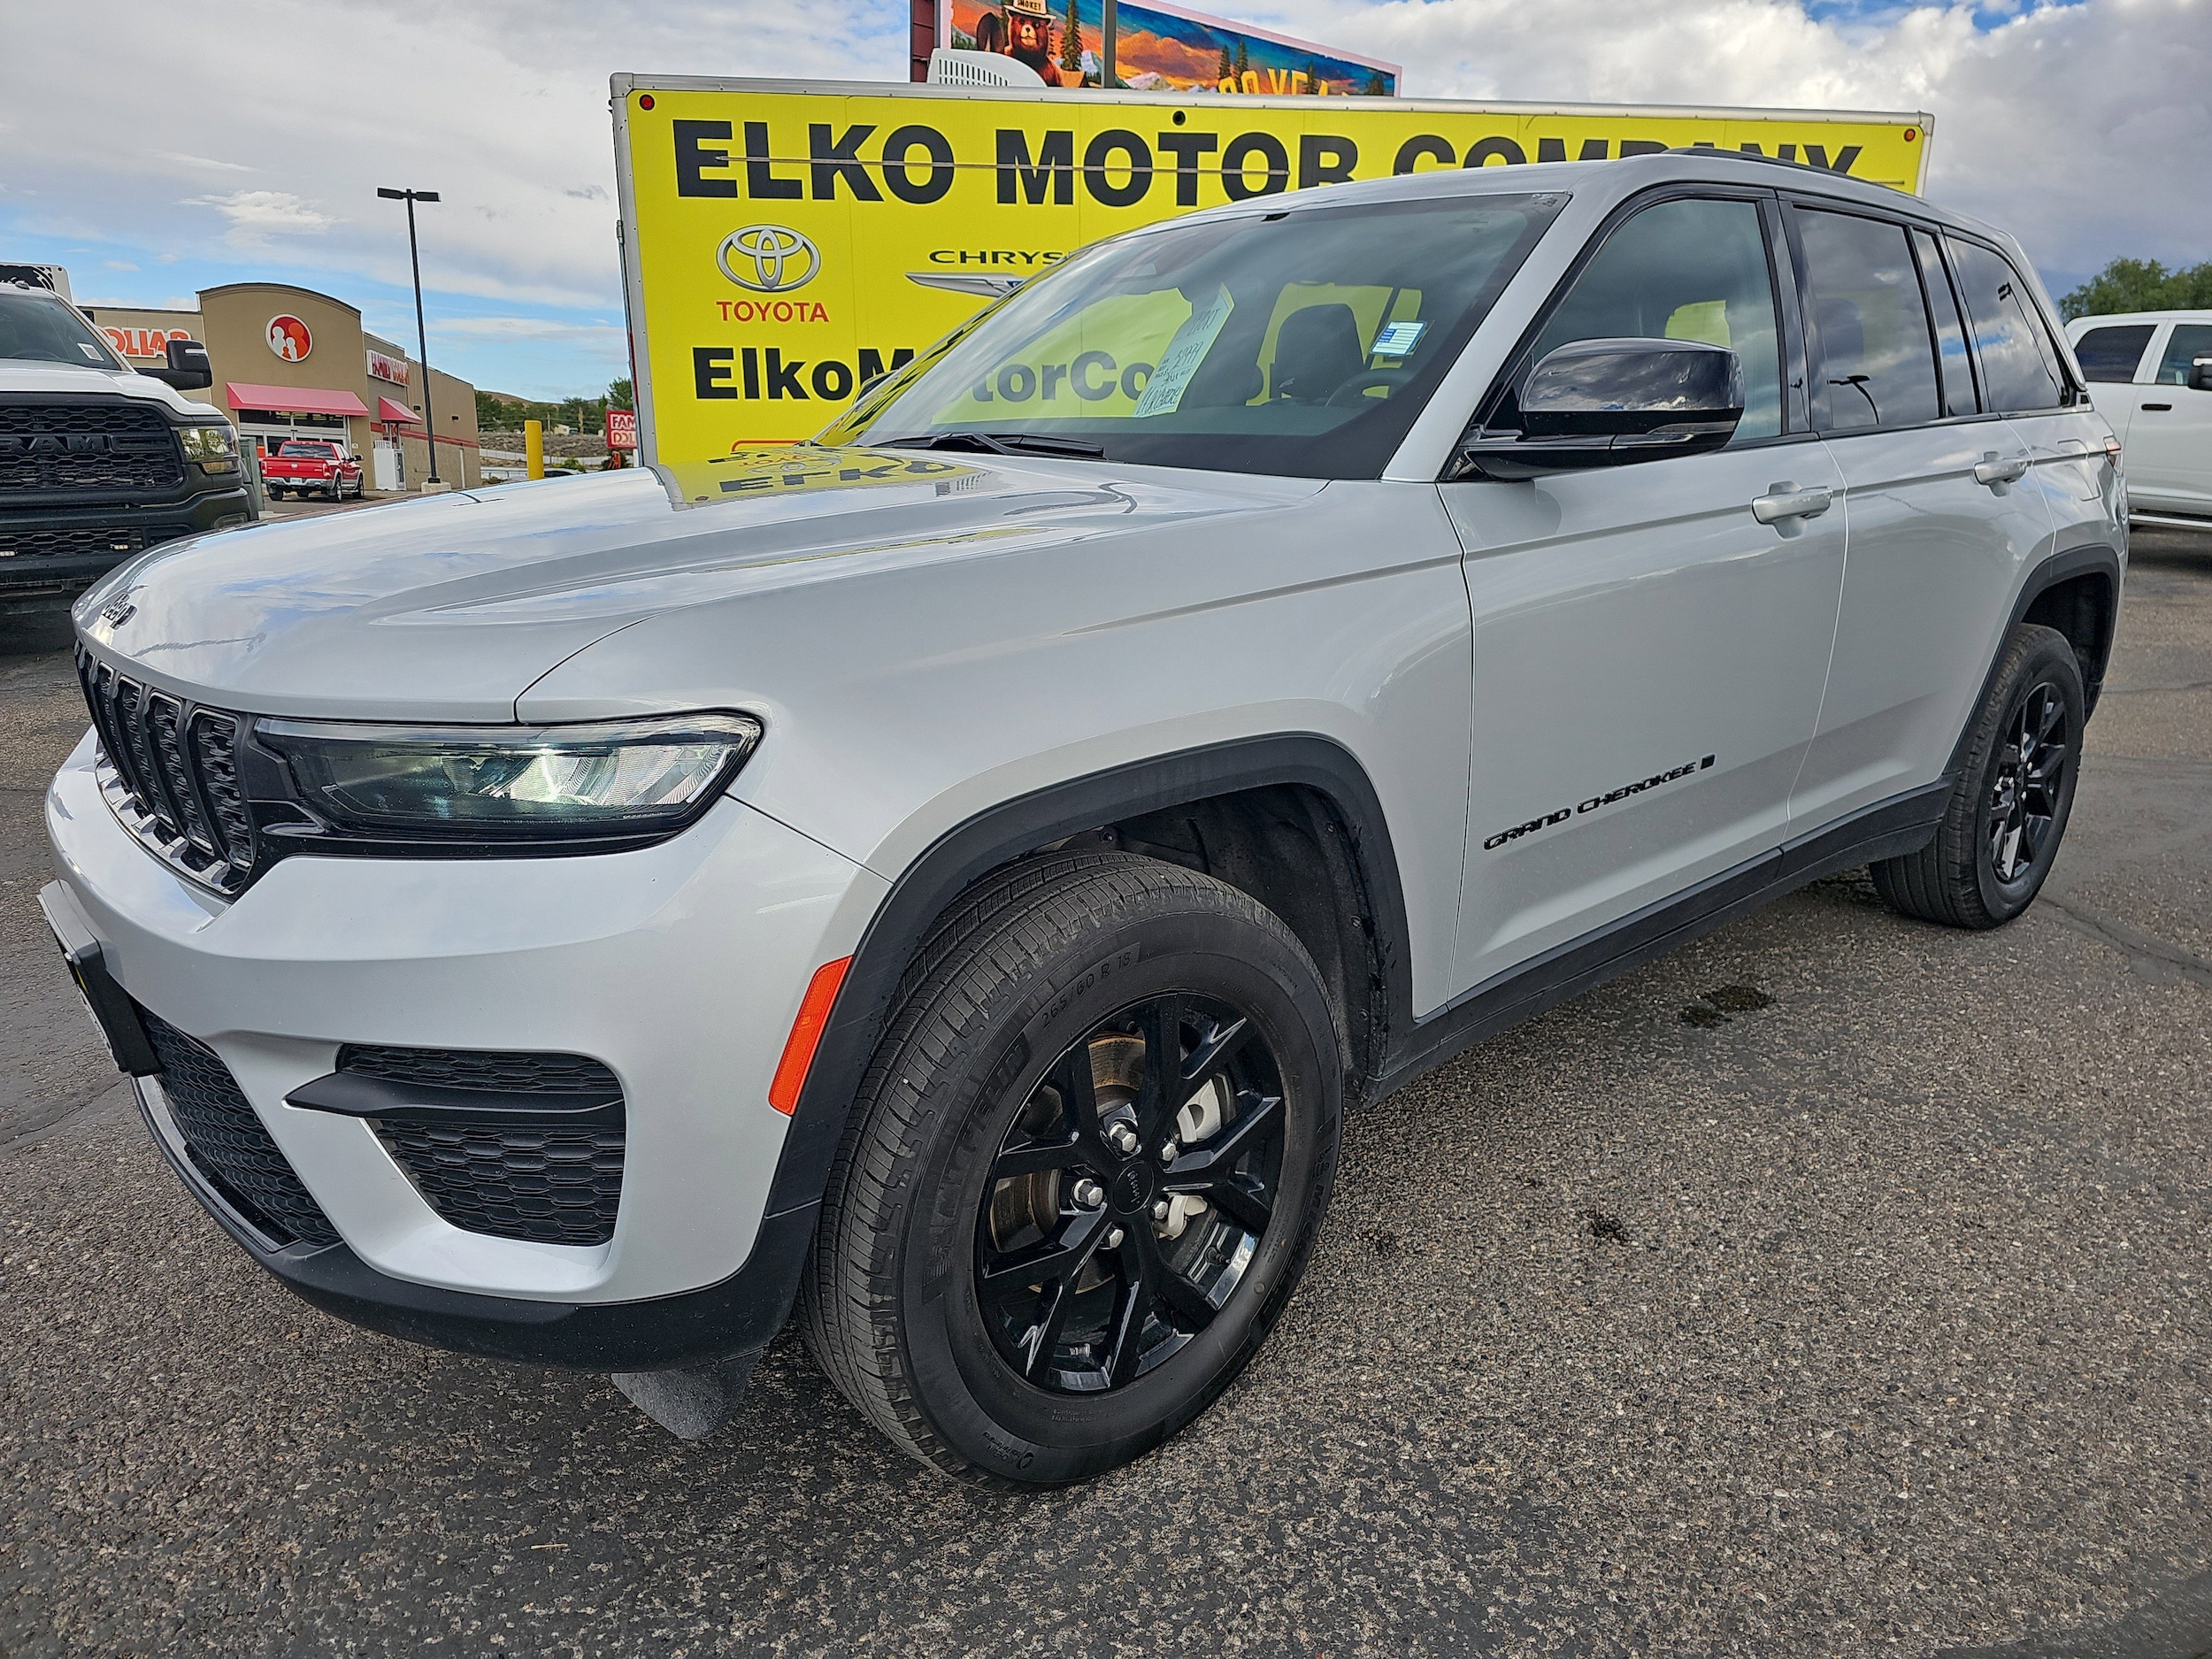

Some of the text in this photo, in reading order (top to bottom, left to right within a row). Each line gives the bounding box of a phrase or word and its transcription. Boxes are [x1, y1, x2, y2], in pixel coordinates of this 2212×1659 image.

[672, 119, 955, 204] ELKO
[995, 129, 1358, 207] MOTOR
[717, 301, 829, 323] TOYOTA
[99, 328, 189, 357] OLLA
[1483, 761, 1697, 850] GRAND CHEROKEE
